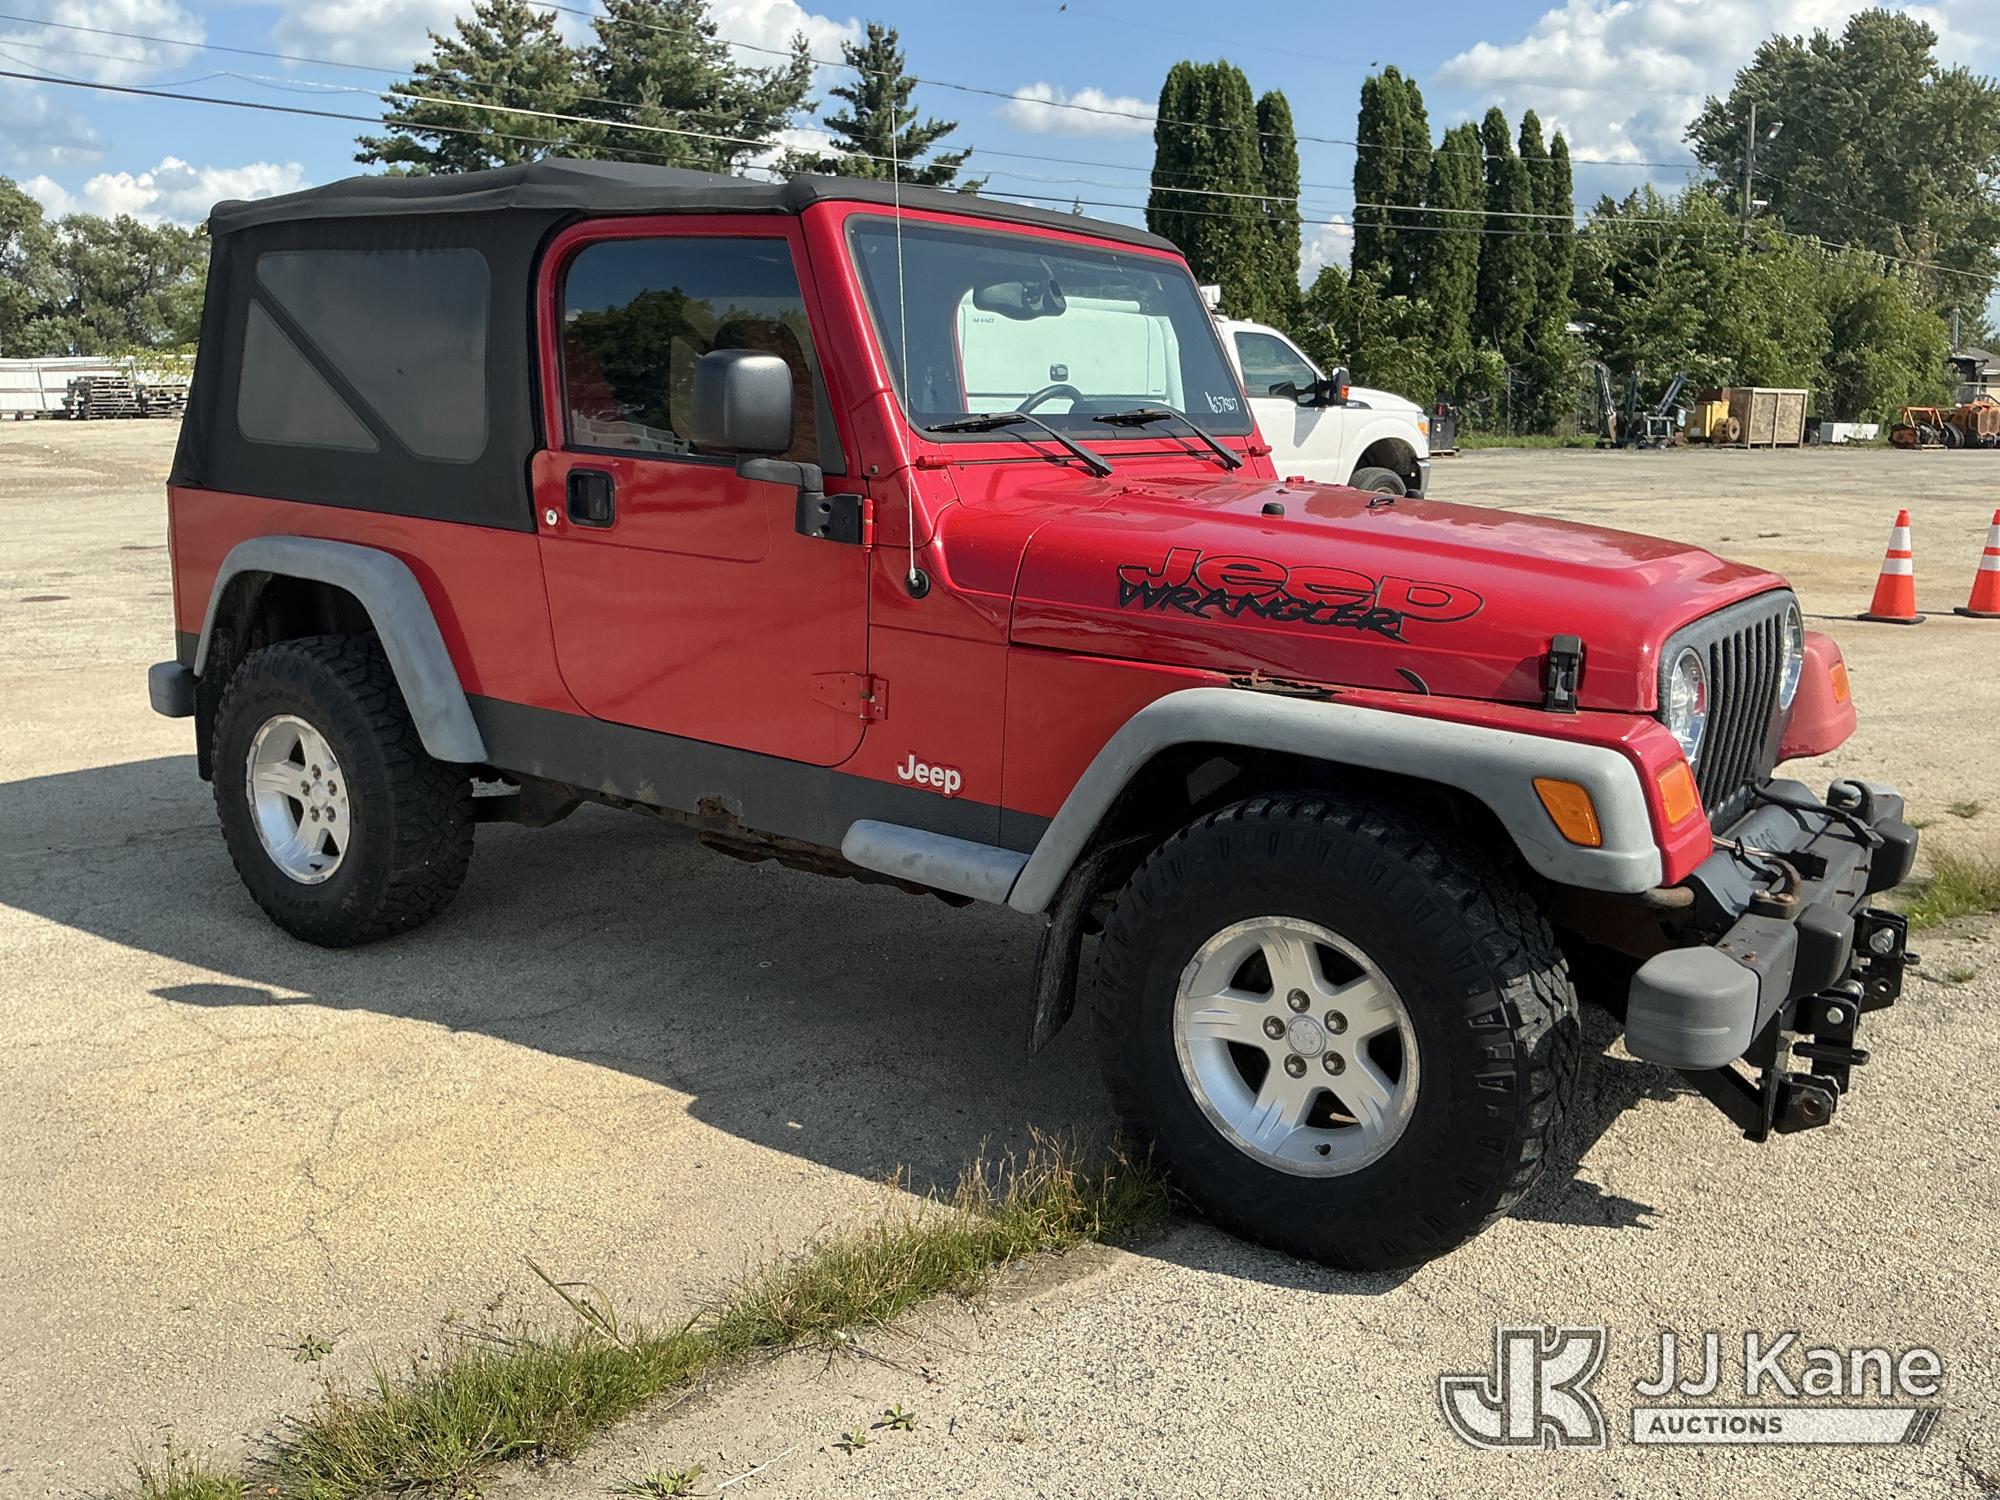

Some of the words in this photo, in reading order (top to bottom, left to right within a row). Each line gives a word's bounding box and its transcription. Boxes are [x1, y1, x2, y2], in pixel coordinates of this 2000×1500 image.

[1117, 546, 1485, 634] Jeep
[1118, 579, 1410, 644] WRANGLER
[897, 754, 961, 795] Jeep
